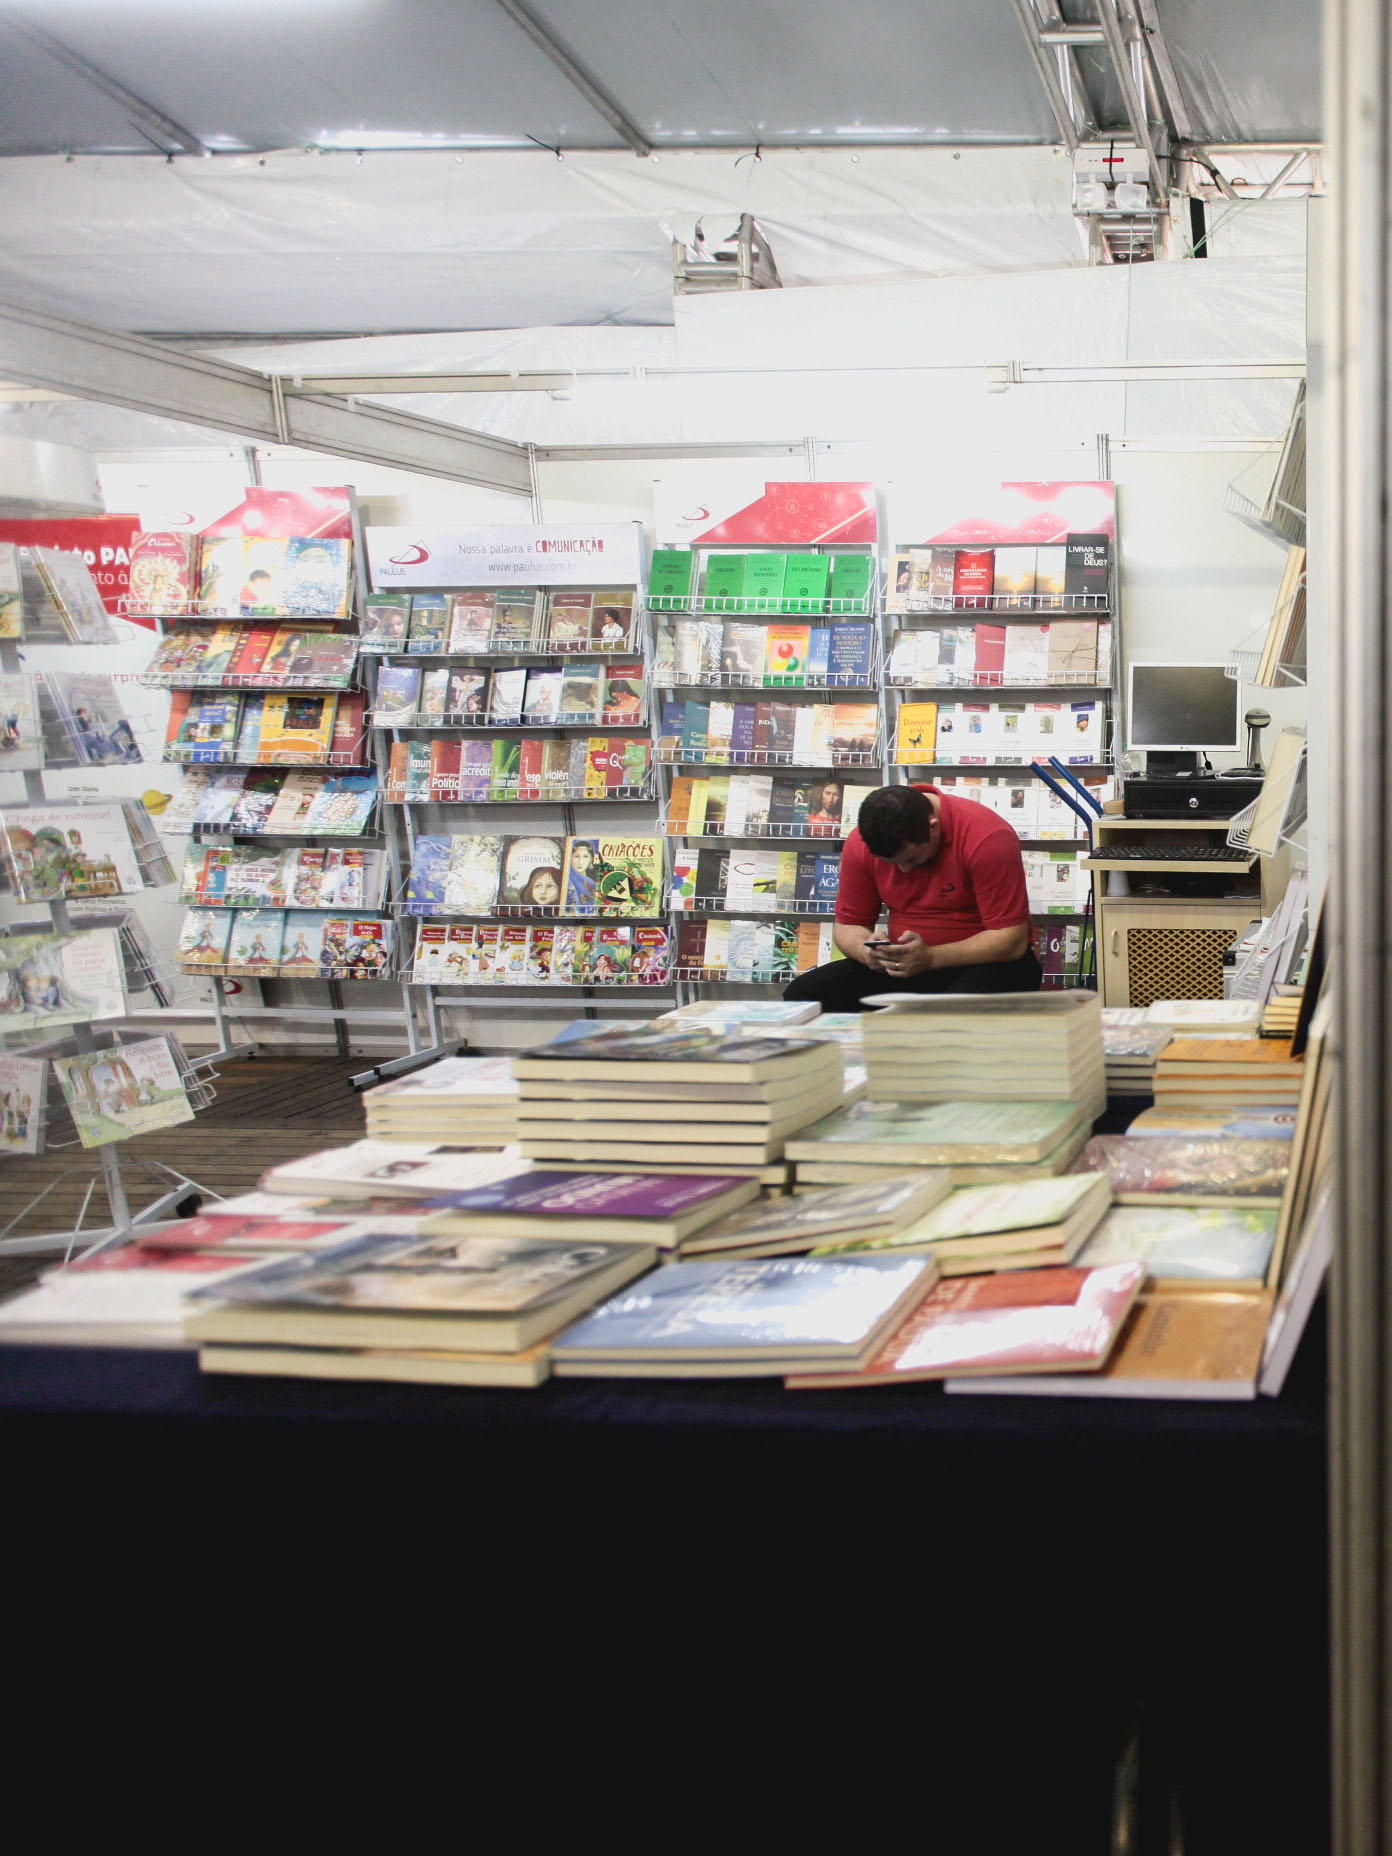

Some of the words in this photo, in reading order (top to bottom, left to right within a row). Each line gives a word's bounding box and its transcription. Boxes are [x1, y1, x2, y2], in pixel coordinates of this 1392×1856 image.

[459, 544, 487, 554] Nossa
[490, 544, 524, 556] palavra
[535, 537, 604, 556] COMUNICAÇÃO
[1068, 545, 1105, 554] LIVRAR-SE
[1084, 559, 1108, 567] DEUS?
[379, 568, 405, 576] PAULUS
[462, 766, 492, 777] acredit
[543, 770, 568, 780] violên
[431, 777, 460, 788] Polític
[517, 855, 551, 864] GRIMM
